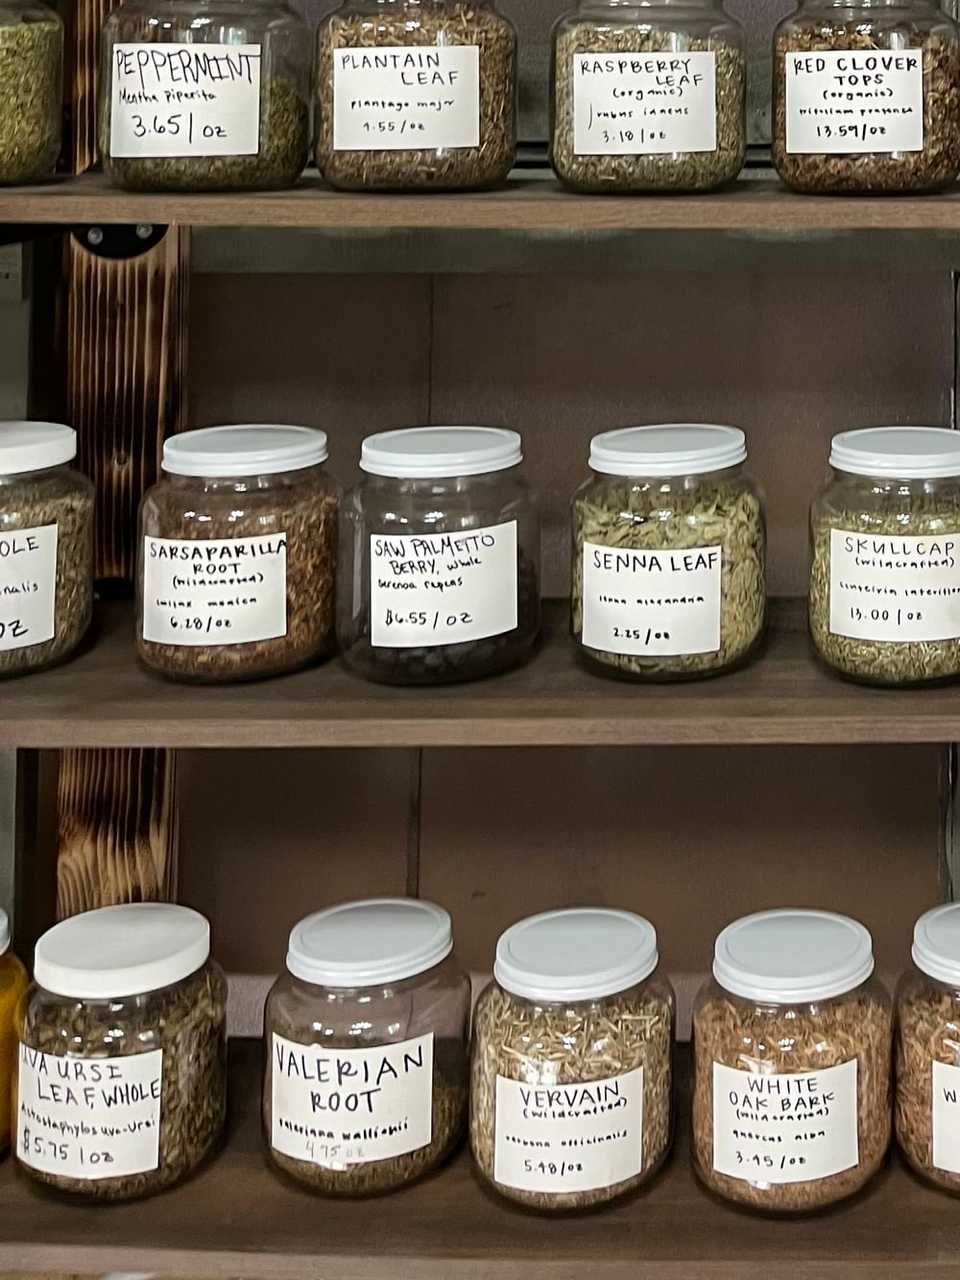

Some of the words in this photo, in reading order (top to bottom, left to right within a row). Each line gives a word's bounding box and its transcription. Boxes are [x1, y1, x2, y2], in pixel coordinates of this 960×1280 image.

[116, 49, 262, 90] PEPPERMINT
[341, 52, 440, 70] PLANTAIN
[580, 58, 691, 75] RASPBERRY
[793, 58, 826, 76] RED
[836, 56, 919, 72] CLOVER
[400, 70, 458, 86] LEAF
[655, 74, 704, 86] LEAF
[833, 74, 884, 86] TOPS
[612, 86, 684, 101] (organic)
[822, 87, 894, 101] (organic)
[131, 112, 228, 144] 3.65/oz
[816, 123, 887, 141] 13.59/oz
[150, 539, 287, 561] SARSAPARILLA
[374, 538, 405, 557] SAW
[410, 534, 496, 557] PALMETTO
[844, 536, 956, 558] SKULLCAP
[193, 562, 241, 575] ROOT
[592, 550, 663, 572] SENNA
[670, 551, 719, 571] LEAF
[57, 1060, 123, 1083] URSI
[275, 1041, 424, 1086] VALERIAN
[101, 1078, 161, 1108] WHOLE
[519, 1080, 620, 1108] VERVAIN
[747, 1076, 818, 1095] WHITE
[310, 1087, 382, 1113] ROOT
[729, 1090, 770, 1111] OAK
[780, 1091, 836, 1112] BARK
